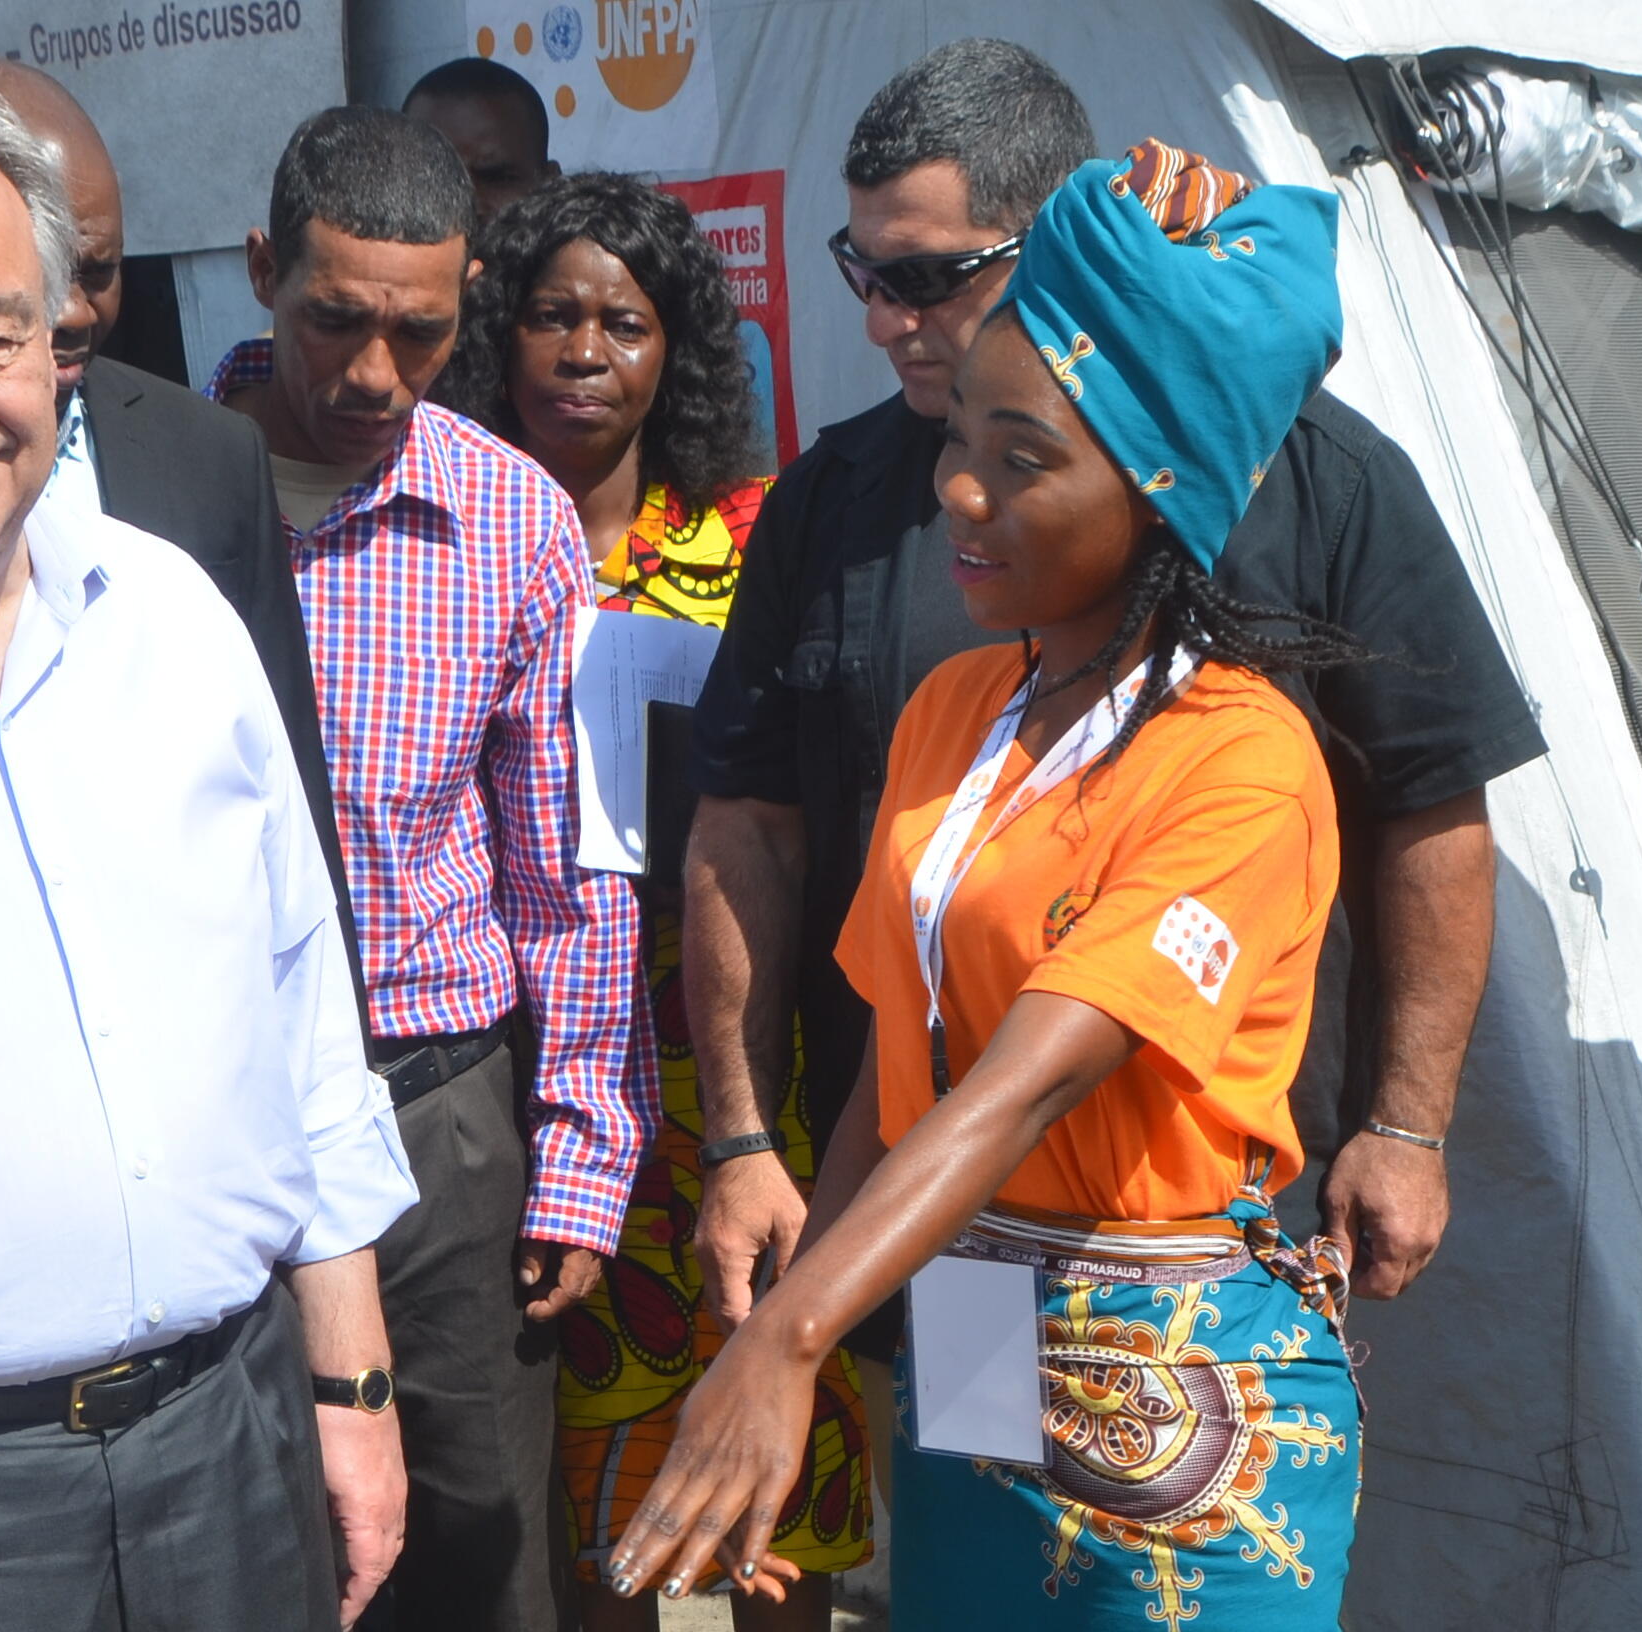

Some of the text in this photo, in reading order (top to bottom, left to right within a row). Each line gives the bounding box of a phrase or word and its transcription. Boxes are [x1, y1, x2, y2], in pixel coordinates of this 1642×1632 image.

[30, 23, 112, 69] Grupos
[117, 9, 145, 52] de
[597, 0, 698, 60] UNFPA
[707, 226, 761, 255] ores
